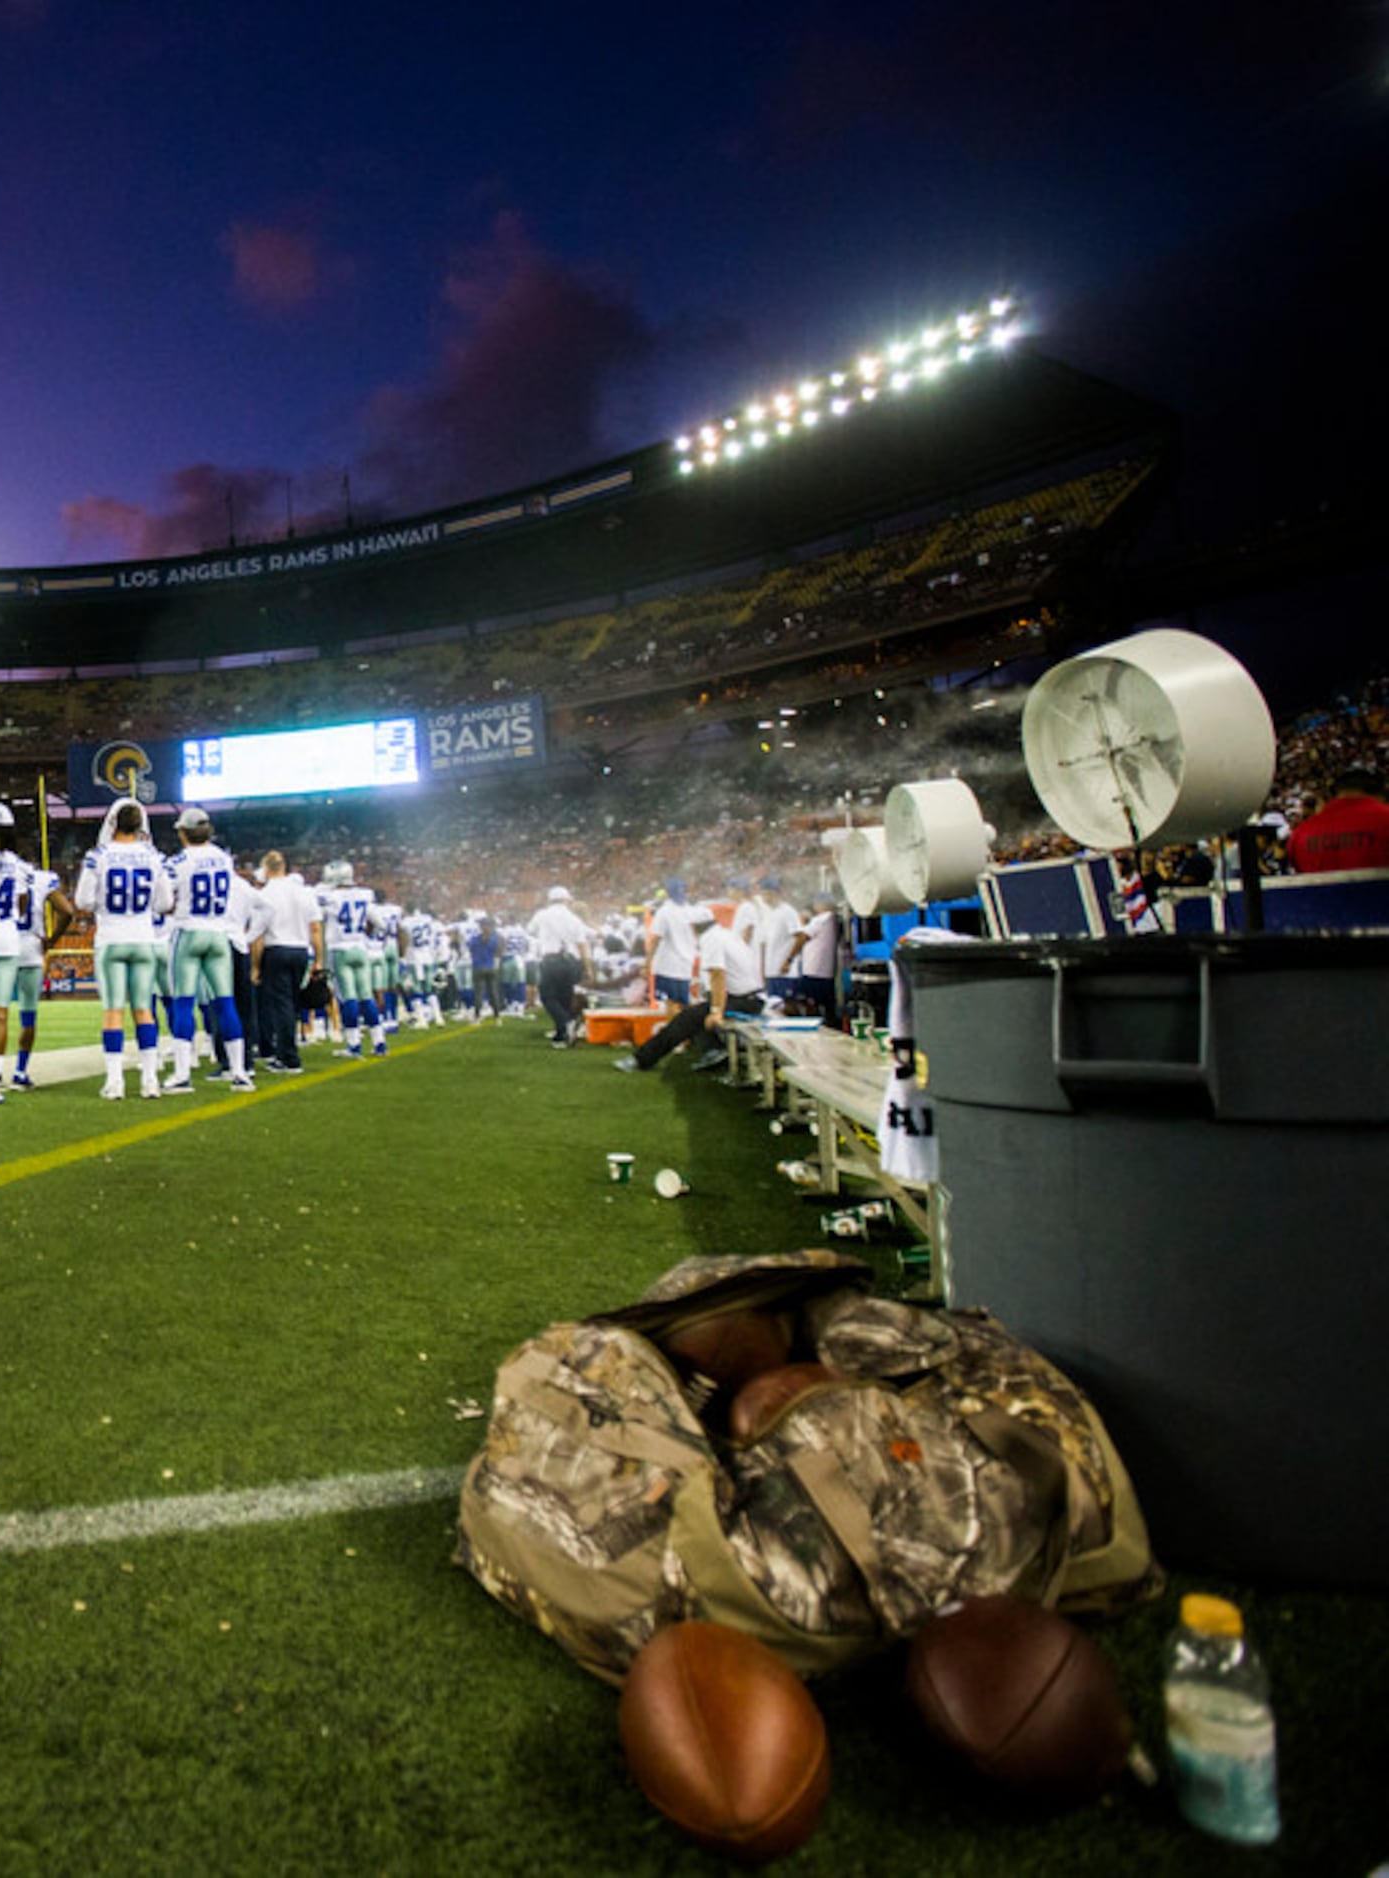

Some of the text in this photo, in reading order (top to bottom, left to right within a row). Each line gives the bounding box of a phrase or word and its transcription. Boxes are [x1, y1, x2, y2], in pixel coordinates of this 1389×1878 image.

[119, 569, 159, 588] LOS
[166, 557, 262, 585] ANGELES
[269, 546, 330, 572] RAMS
[332, 540, 355, 560] IN
[428, 703, 531, 729] LOS ANGELES
[430, 716, 534, 756] RAMS
[106, 868, 152, 914] 86
[190, 869, 230, 916] 89
[338, 900, 368, 934] 47
